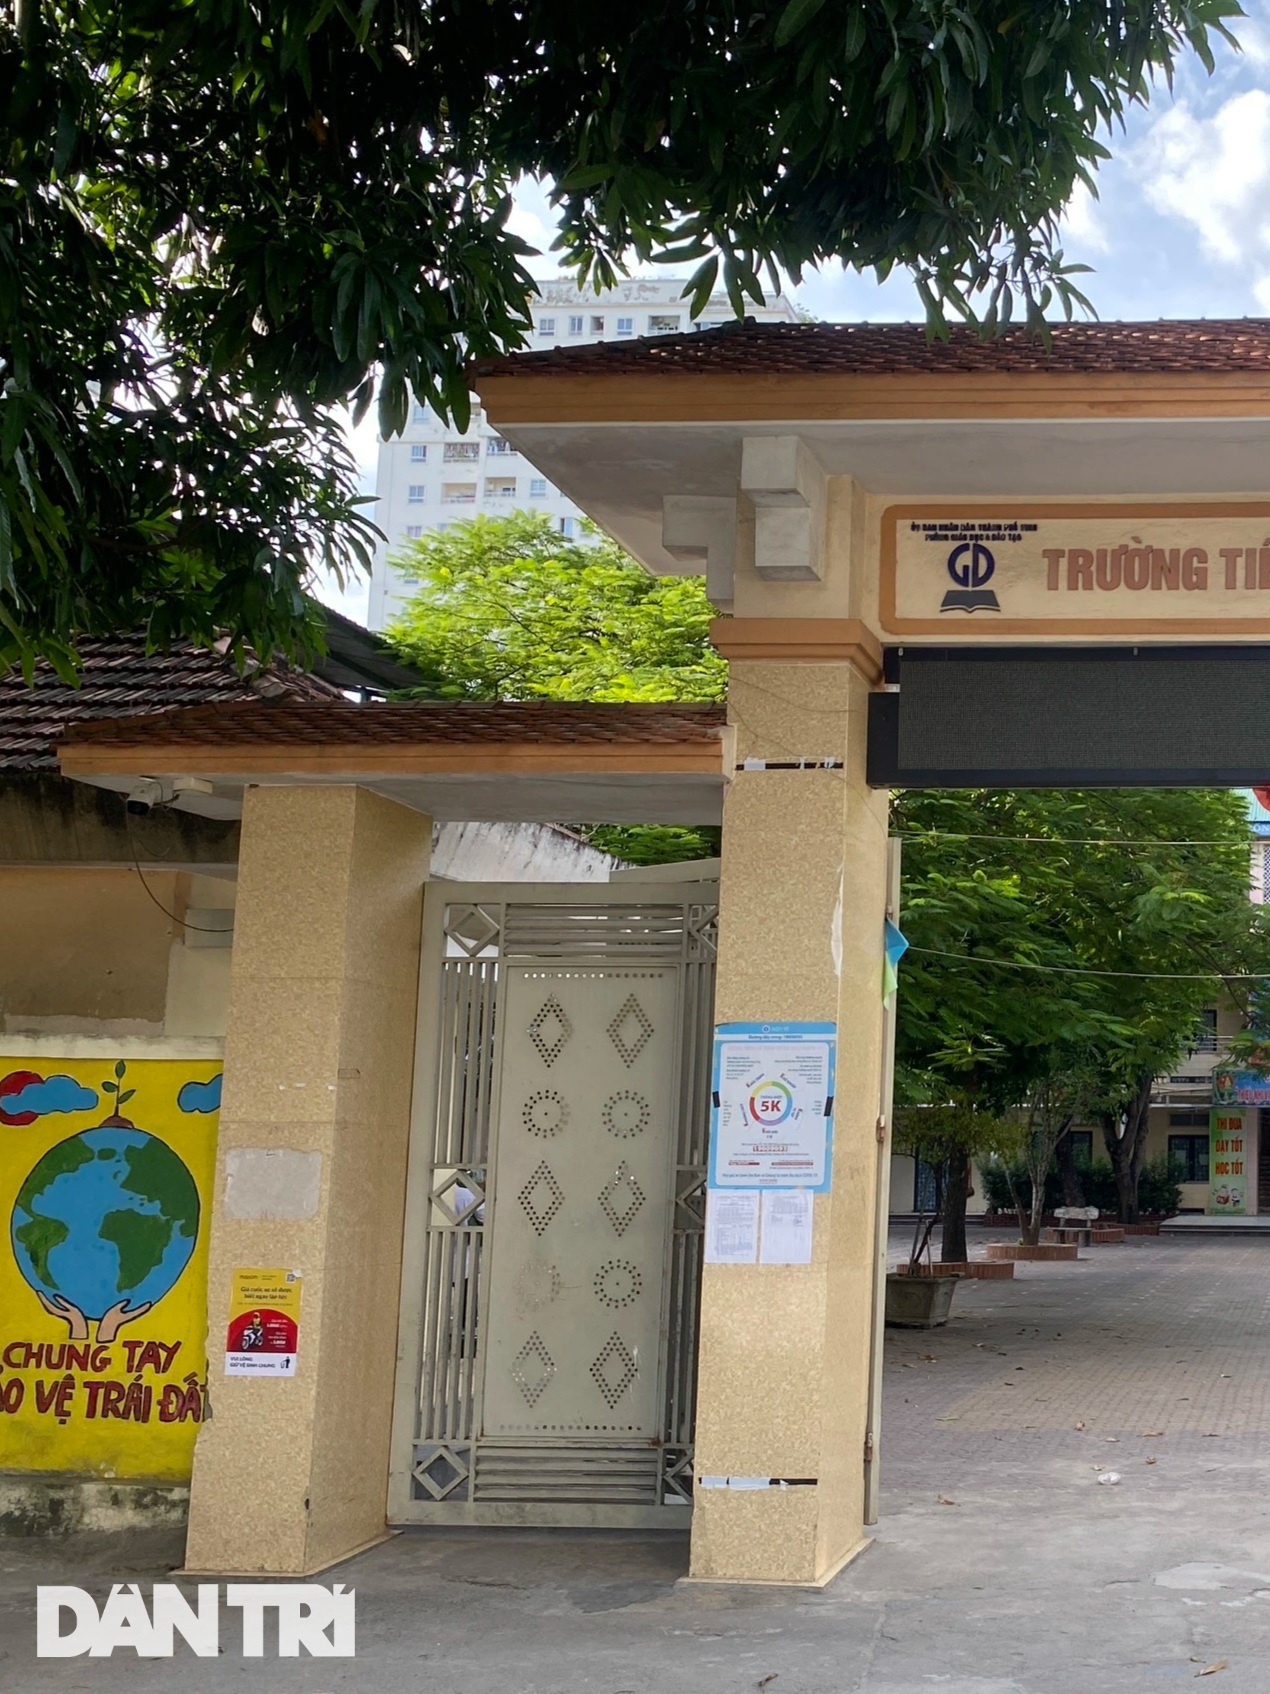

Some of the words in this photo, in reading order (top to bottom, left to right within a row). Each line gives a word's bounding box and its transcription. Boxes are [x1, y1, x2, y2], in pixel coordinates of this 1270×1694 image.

[1041, 535, 1209, 591] TRƯỜNG
[760, 1100, 781, 1112] 5K
[1231, 1135, 1243, 1152] TỐT
[1215, 1161, 1229, 1176] HỌC
[1231, 1157, 1243, 1175] TỐT
[2, 1341, 112, 1373] CHUNG
[122, 1340, 182, 1373] TAY
[35, 1373, 76, 1425] VỆ
[82, 1374, 152, 1424] TRÁI
